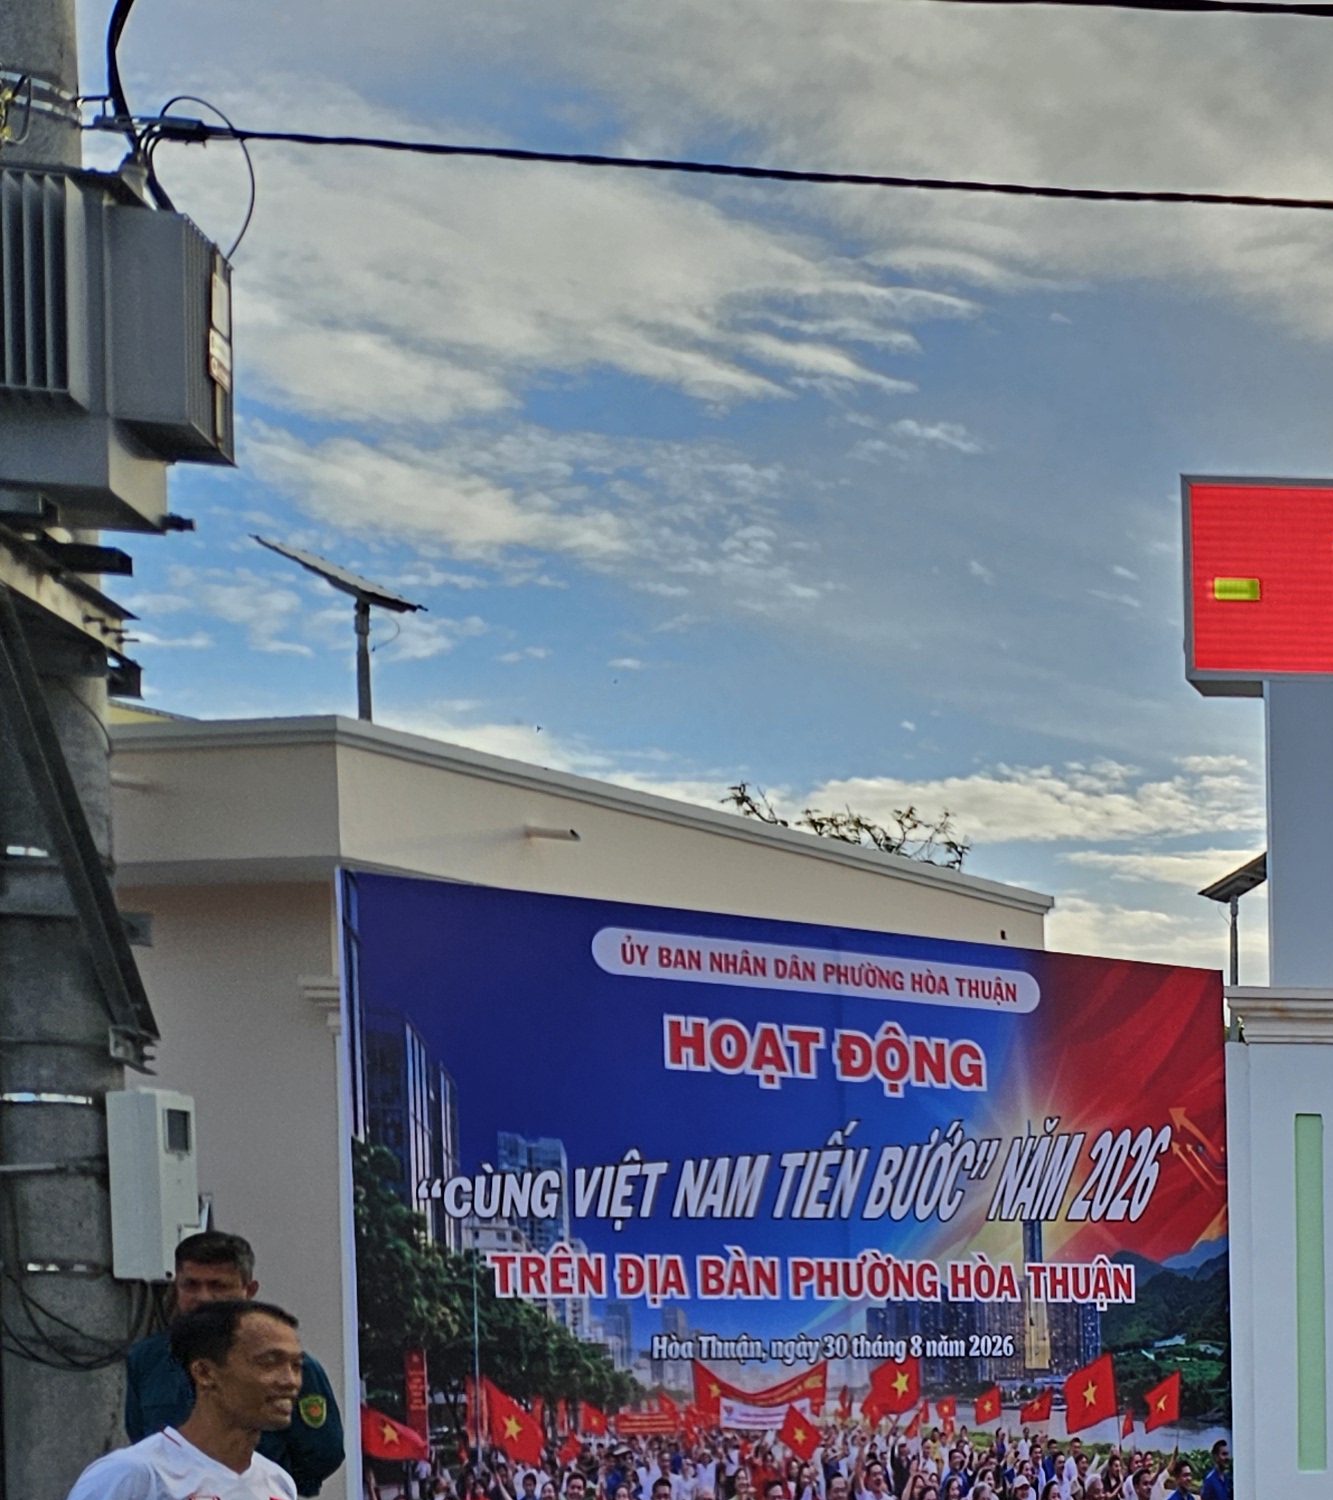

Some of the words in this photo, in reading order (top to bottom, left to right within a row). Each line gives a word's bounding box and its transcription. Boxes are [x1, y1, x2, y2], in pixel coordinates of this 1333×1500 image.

[1214, 577, 1260, 600] -
[621, 935, 649, 966] ỦY
[658, 946, 702, 971] BAN
[709, 949, 767, 977] NHÂN
[774, 954, 816, 981] DÂN
[823, 961, 905, 991] PHƯỜNG
[910, 968, 950, 996] HÒA
[955, 976, 1017, 1006] THUẬN
[666, 1017, 823, 1087] HOẠT
[835, 1024, 985, 1095] ĐỘNG
[574, 1148, 668, 1231] VIỆT
[672, 1154, 771, 1218] NAM
[772, 1120, 870, 1219] TIẾN
[988, 1117, 1085, 1220] NĂM
[1066, 1126, 1172, 1221] 2026
[490, 1244, 604, 1297] TRÊN
[616, 1256, 688, 1306] ĐỊA
[698, 1246, 779, 1298] BÀN
[790, 1250, 939, 1299] PHƯỜNG
[949, 1252, 1019, 1300] HÒA
[1026, 1256, 1133, 1309] THUẬN
[652, 1333, 694, 1359] Hòa
[699, 1333, 767, 1364] Thuận,
[771, 1333, 820, 1366] ngày
[823, 1335, 848, 1358] 30
[852, 1334, 907, 1364] tháng
[910, 1335, 923, 1358] 8
[926, 1334, 966, 1358] năm
[968, 1335, 1014, 1358] 2026
